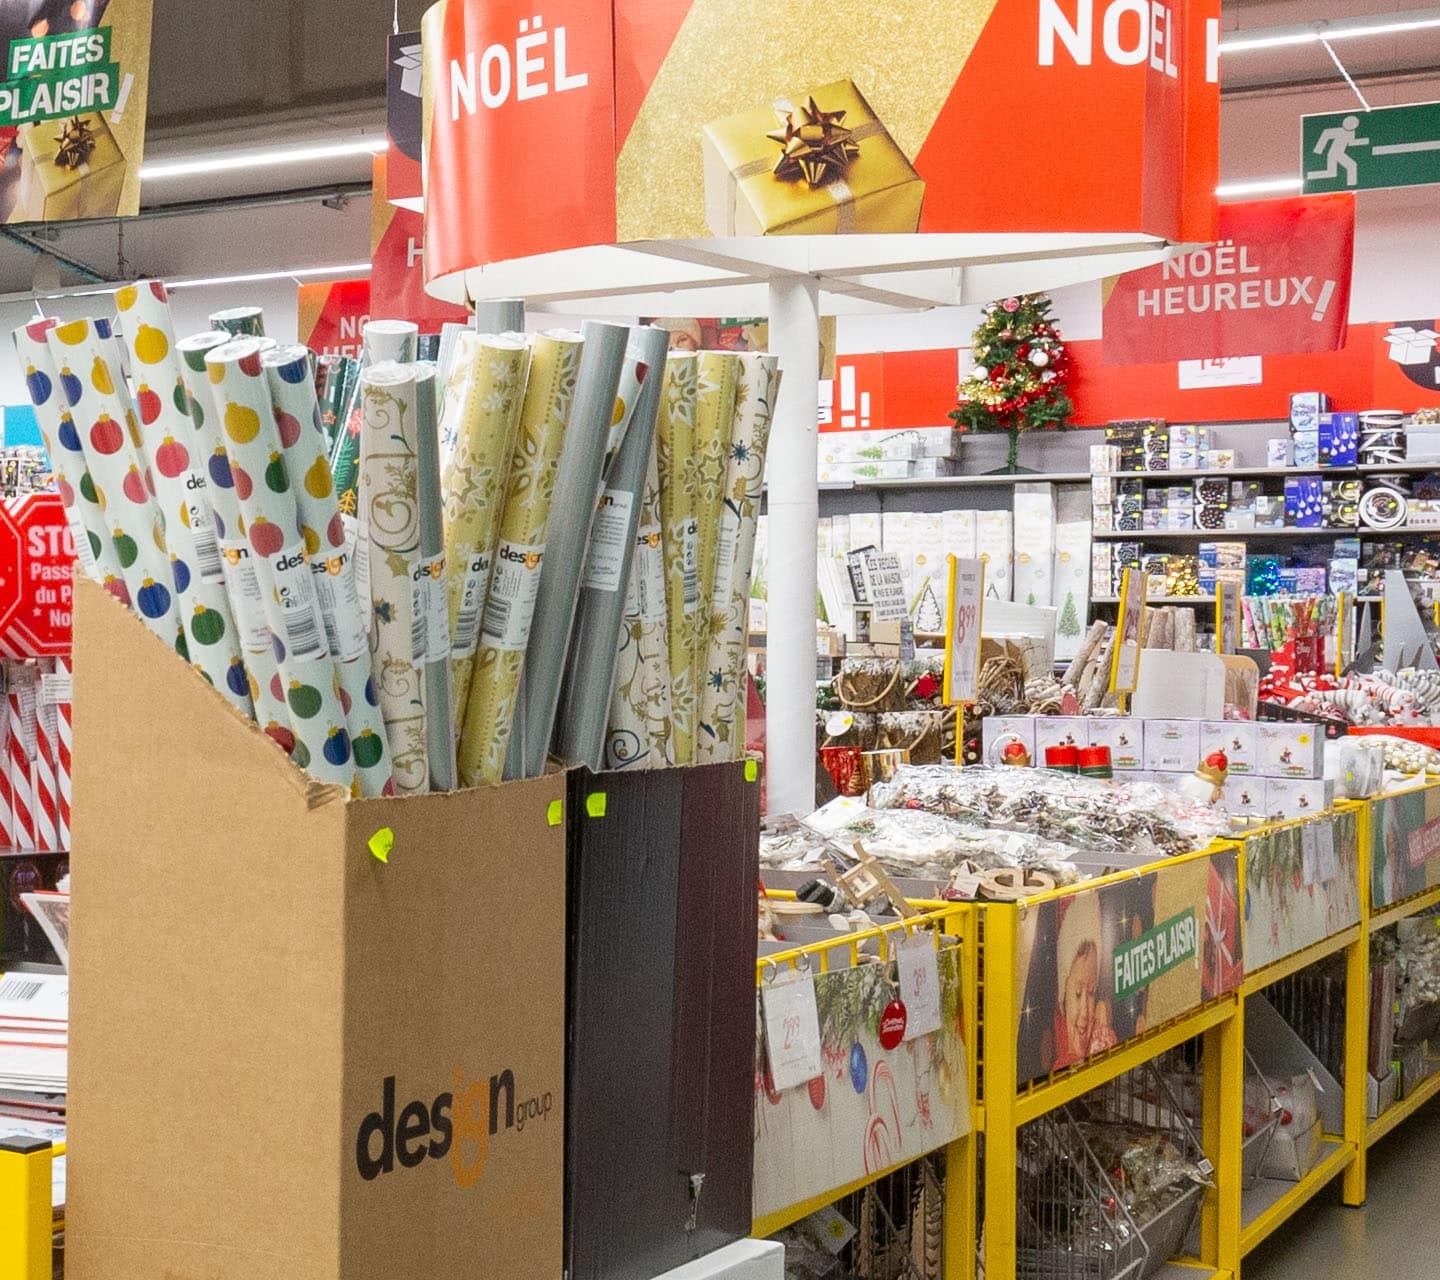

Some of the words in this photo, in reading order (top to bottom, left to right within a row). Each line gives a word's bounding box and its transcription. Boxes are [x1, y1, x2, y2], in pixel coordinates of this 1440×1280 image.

[12, 32, 103, 76] FAITES
[451, 16, 588, 121] NOËL
[1161, 239, 1259, 281] NOËL
[28, 525, 77, 558] STO
[31, 563, 73, 580] Pass
[36, 586, 55, 604] du
[50, 611, 72, 628] No
[1114, 941, 1156, 994] FAITES
[356, 1067, 514, 1187] design
[516, 1091, 553, 1132] group
